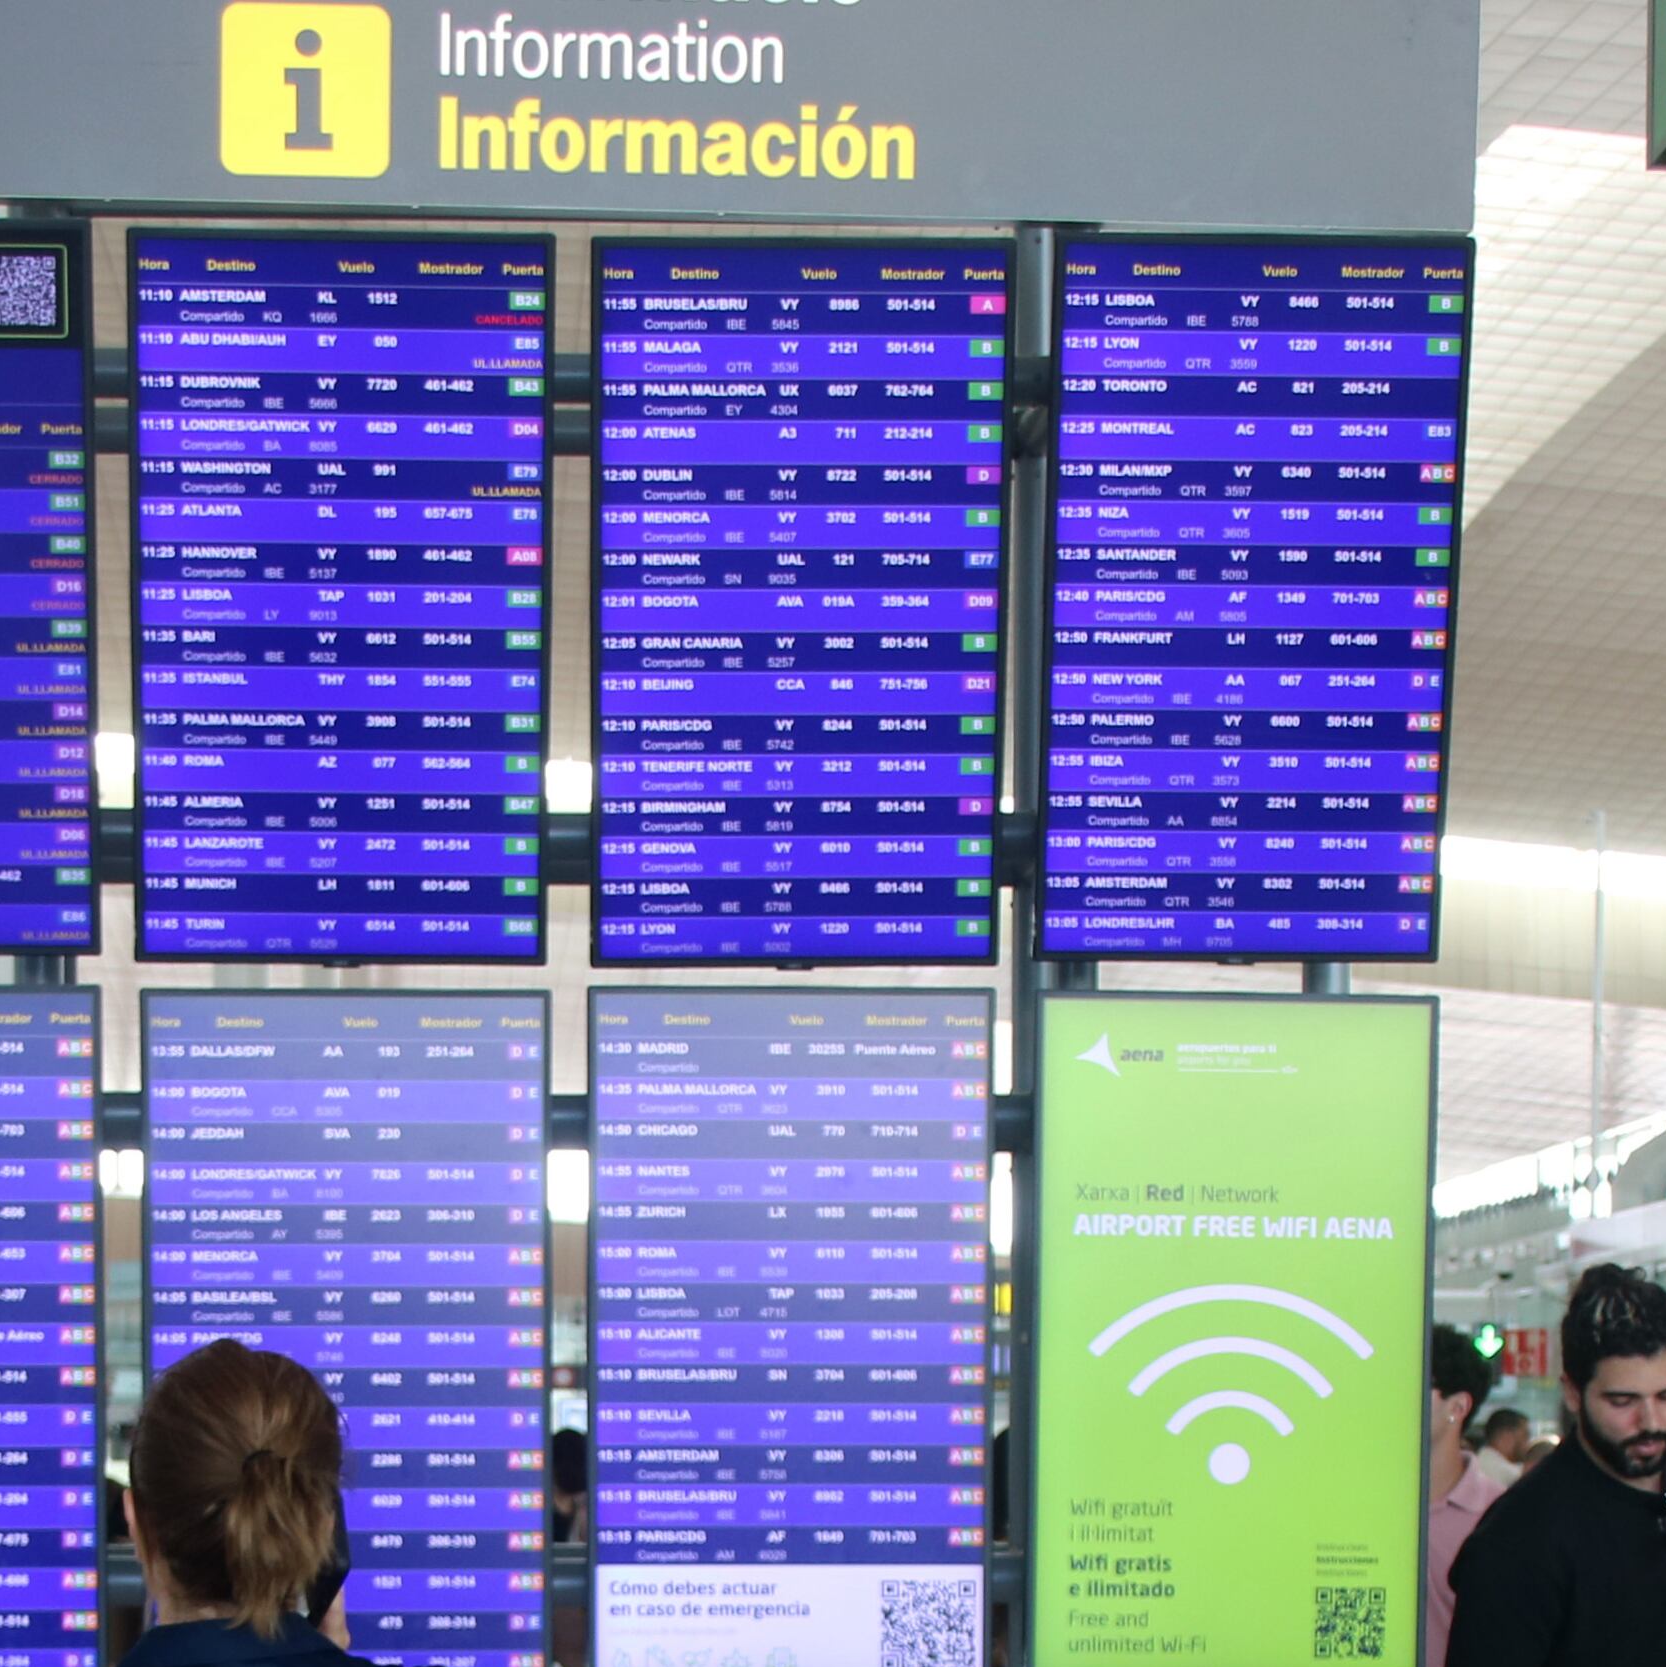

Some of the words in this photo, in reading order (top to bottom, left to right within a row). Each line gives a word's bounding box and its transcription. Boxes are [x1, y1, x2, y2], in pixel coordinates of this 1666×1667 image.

[440, 12, 784, 85] Information
[439, 96, 915, 181] Información
[139, 259, 169, 271] Hora
[207, 260, 255, 272] Destino
[339, 261, 375, 273] Vuelo
[419, 262, 484, 275] Mostrador
[503, 263, 544, 275] Puerta
[1067, 264, 1096, 275] Hora
[1133, 265, 1180, 276] Destino
[1263, 266, 1297, 278] Vuelo
[1341, 266, 1404, 278] Mostrador
[1424, 267, 1463, 280] Puerta
[604, 269, 634, 280] Hora
[671, 269, 719, 281] Destino
[802, 269, 837, 281] Vuelo
[881, 269, 945, 281] Mostrador
[964, 269, 1004, 281] Puerta
[140, 290, 173, 302] 11:10
[180, 290, 266, 303] AMSTERDAM
[318, 293, 337, 304] KL
[367, 293, 397, 304] 1512
[515, 294, 540, 306] B24
[604, 298, 637, 310] 11:55
[644, 298, 748, 311] BRUSELAS/BRU
[780, 299, 799, 310] VY
[887, 299, 935, 311] 501-514
[982, 299, 993, 310] A
[1066, 294, 1099, 306] 12:15
[1105, 295, 1155, 307] LISBOA
[1241, 296, 1260, 307] VY
[1346, 297, 1394, 309] 501-514
[1441, 299, 1451, 309] B
[180, 310, 244, 323] Compartido
[476, 315, 543, 325] CANCELADO
[604, 342, 637, 353] 11:55
[644, 342, 701, 354] MALAGA
[780, 342, 799, 353] VY
[829, 342, 858, 354] 2121
[886, 342, 934, 354] 501-514
[982, 343, 992, 354] B
[141, 376, 174, 388] 11:15
[180, 377, 261, 389] DUBROVNIK
[318, 378, 337, 389] VY
[1063, 380, 1096, 392] 12:20
[1103, 380, 1167, 393] TORONTO
[1238, 382, 1257, 393] AC
[1342, 383, 1390, 395] 205-214
[41, 424, 82, 436] Puerta
[1101, 423, 1174, 436] MONTREAL
[181, 463, 271, 475] WASHINGTON
[50, 1013, 90, 1025] Puerta
[151, 1016, 181, 1028] Hora
[216, 1017, 263, 1028] Destino
[343, 1017, 378, 1029] Vuelo
[421, 1017, 483, 1029] Mostrador
[501, 1018, 540, 1029] Puerta
[600, 1014, 628, 1026] Hora
[664, 1014, 710, 1026] Destino
[790, 1014, 824, 1026] Vuelo
[866, 1014, 928, 1027] Mostrador
[946, 1015, 985, 1027] Puerta
[191, 1045, 275, 1058] DALLAS/DFW
[638, 1042, 689, 1055] MADRID
[855, 1043, 897, 1056] Puente
[1120, 1047, 1164, 1063] aena
[638, 1125, 698, 1137] CHICAGO
[1076, 1184, 1129, 1201] Xarxa
[1146, 1185, 1184, 1202] Red
[1201, 1185, 1279, 1203] Network
[191, 1209, 218, 1222] LOS
[220, 1209, 282, 1222] ANGELES
[1074, 1214, 1186, 1236] AIRPORT
[1193, 1216, 1255, 1237] FREE
[1263, 1217, 1317, 1238] WIFI
[1325, 1218, 1393, 1239] AENA
[1070, 1499, 1106, 1517] Wifi
[1070, 1554, 1108, 1571] Wifi
[1115, 1555, 1172, 1574] gratis
[610, 1580, 658, 1596] Cómo
[664, 1580, 716, 1596] debes
[722, 1581, 776, 1596] actuar
[1069, 1583, 1078, 1597] e
[1088, 1580, 1175, 1597] ilimitado
[610, 1603, 631, 1617] en
[637, 1603, 676, 1617] caso
[682, 1600, 703, 1617] de
[709, 1601, 810, 1620] emergencia
[1069, 1611, 1108, 1627] Free
[1115, 1611, 1148, 1628] and
[1068, 1636, 1155, 1653] unlimited
[1161, 1637, 1207, 1654] Wi-Fi
